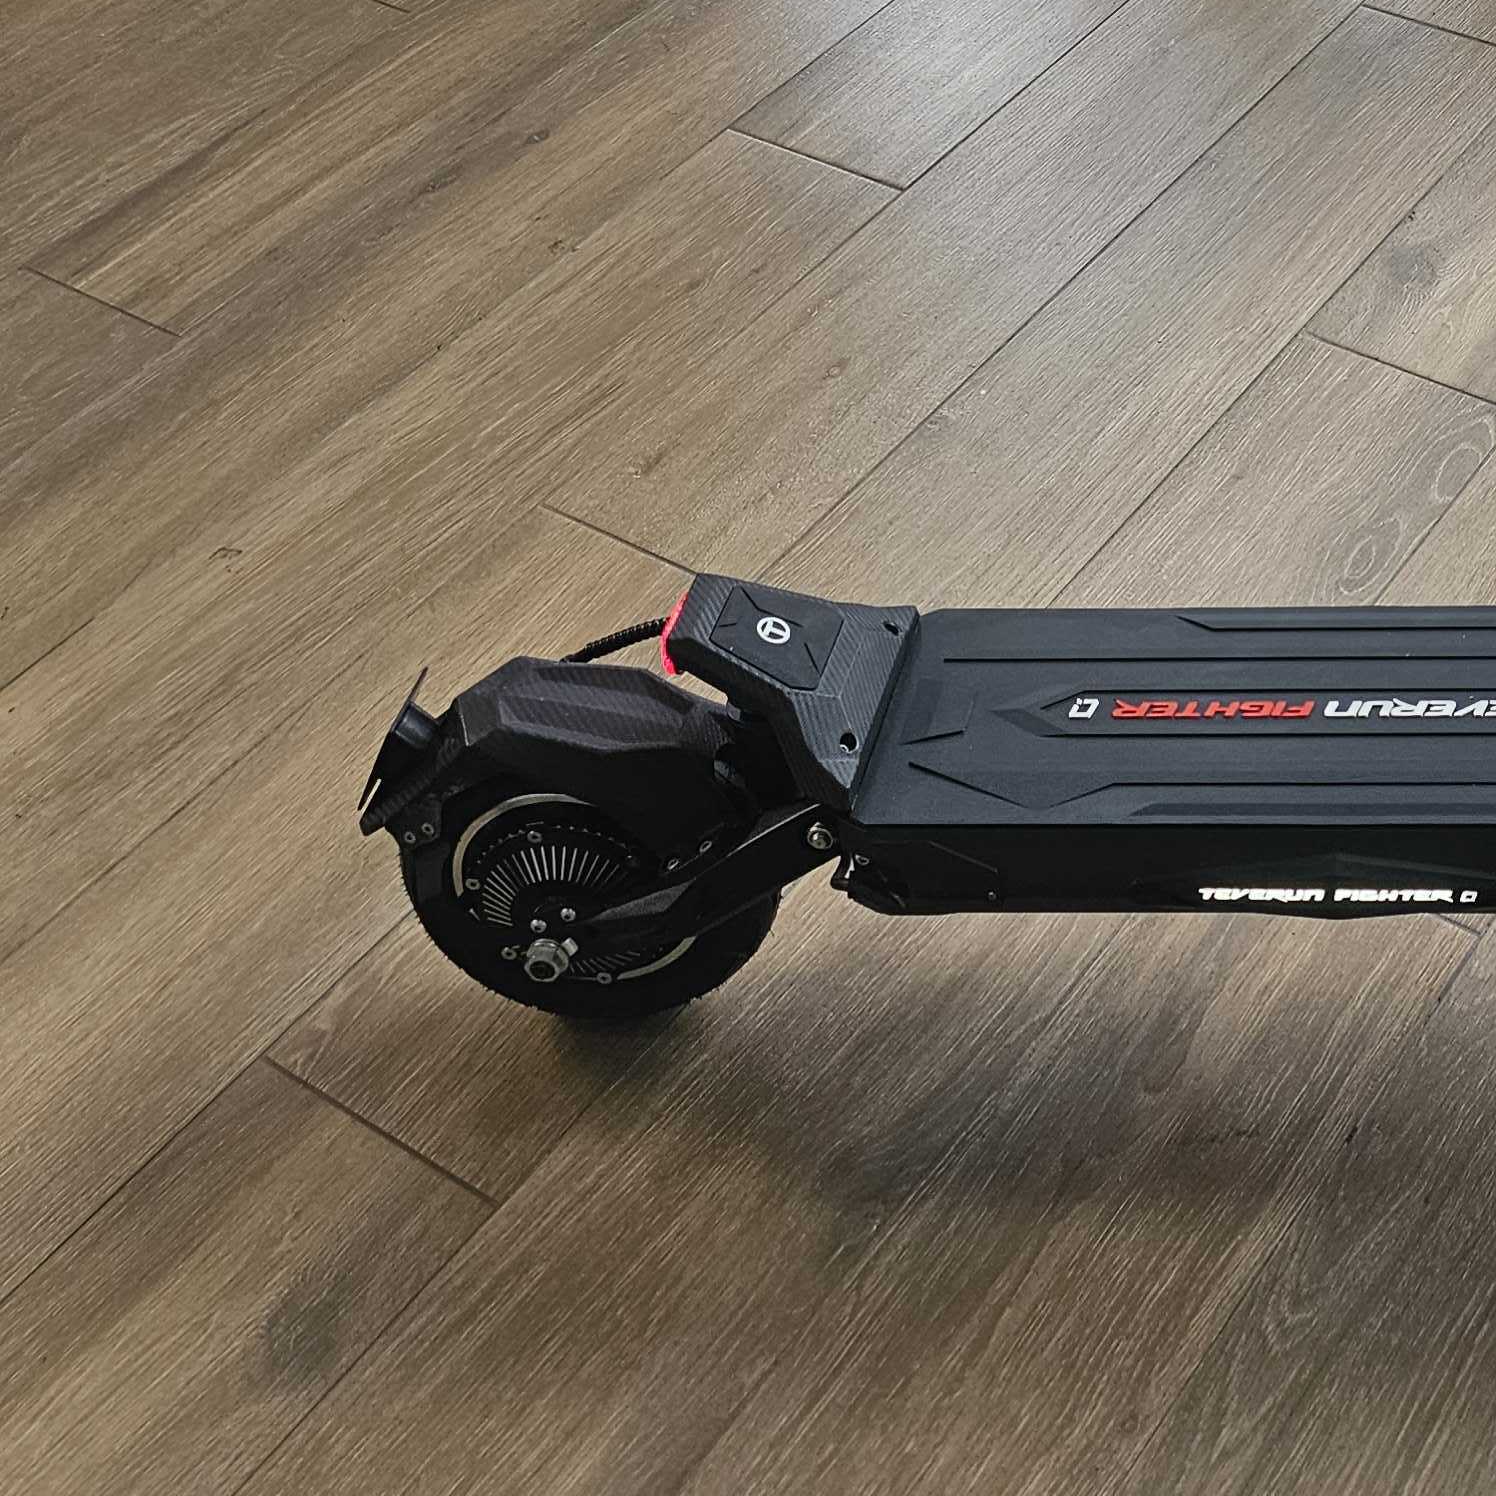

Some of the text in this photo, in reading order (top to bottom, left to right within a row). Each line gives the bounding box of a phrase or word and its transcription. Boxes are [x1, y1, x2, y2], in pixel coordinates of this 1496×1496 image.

[1110, 699, 1319, 720] FIGHTER
[1198, 887, 1324, 903] TEVERUN
[1334, 888, 1453, 903] FIGHTER
